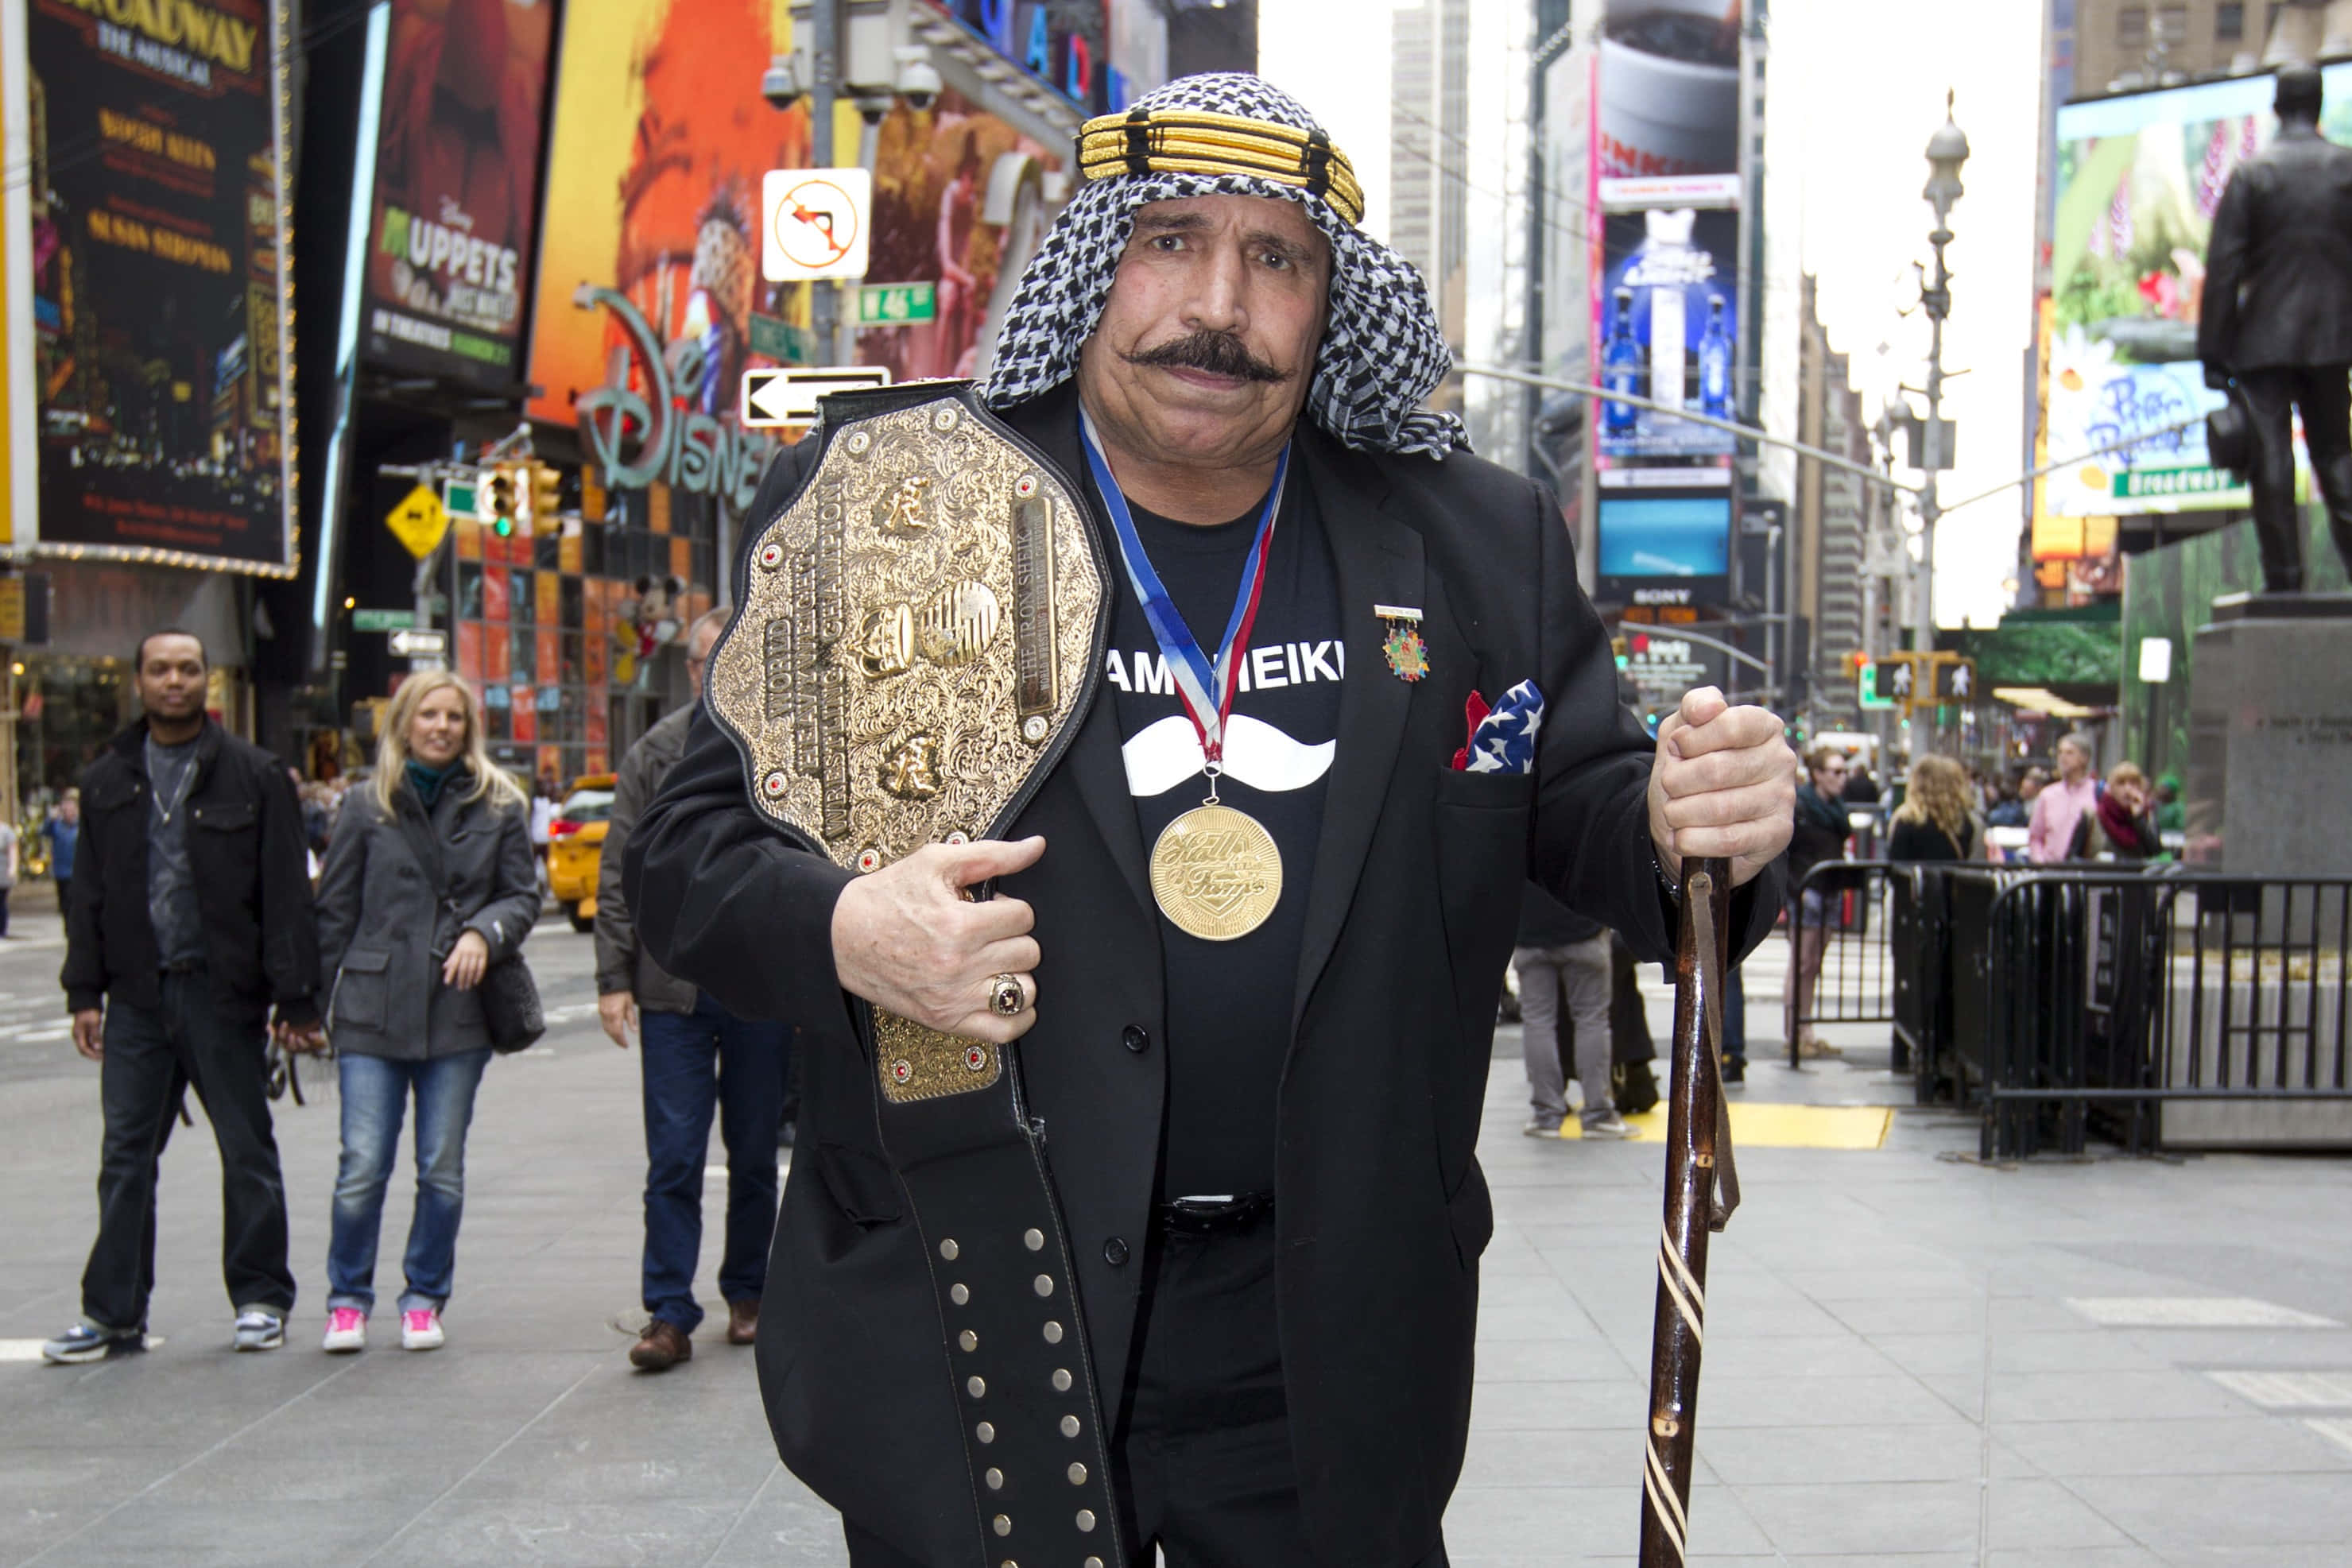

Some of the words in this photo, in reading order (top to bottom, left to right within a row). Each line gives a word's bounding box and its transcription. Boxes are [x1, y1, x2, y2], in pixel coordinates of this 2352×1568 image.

[59, 0, 256, 73] OADWAY
[380, 205, 518, 295] MUPPETS
[882, 288, 909, 318] 46
[2129, 469, 2230, 496] Broadway
[1017, 528, 1035, 587] SHEIK
[1034, 513, 1045, 556] CHAMPION
[819, 482, 844, 641] CHAMPION
[1035, 559, 1048, 610] FEDERATION
[1019, 593, 1037, 639] IRON
[1633, 588, 1692, 606] SONY
[1037, 612, 1050, 660] WRESTLING
[767, 618, 793, 716] WORLD
[794, 552, 820, 771] HEAVYWEIGHT
[1021, 645, 1037, 683] THE
[1038, 661, 1050, 691] WORLD
[821, 666, 848, 833] WRESTLING
[1161, 830, 1245, 868] Hall
[1184, 866, 1269, 899] Fame
